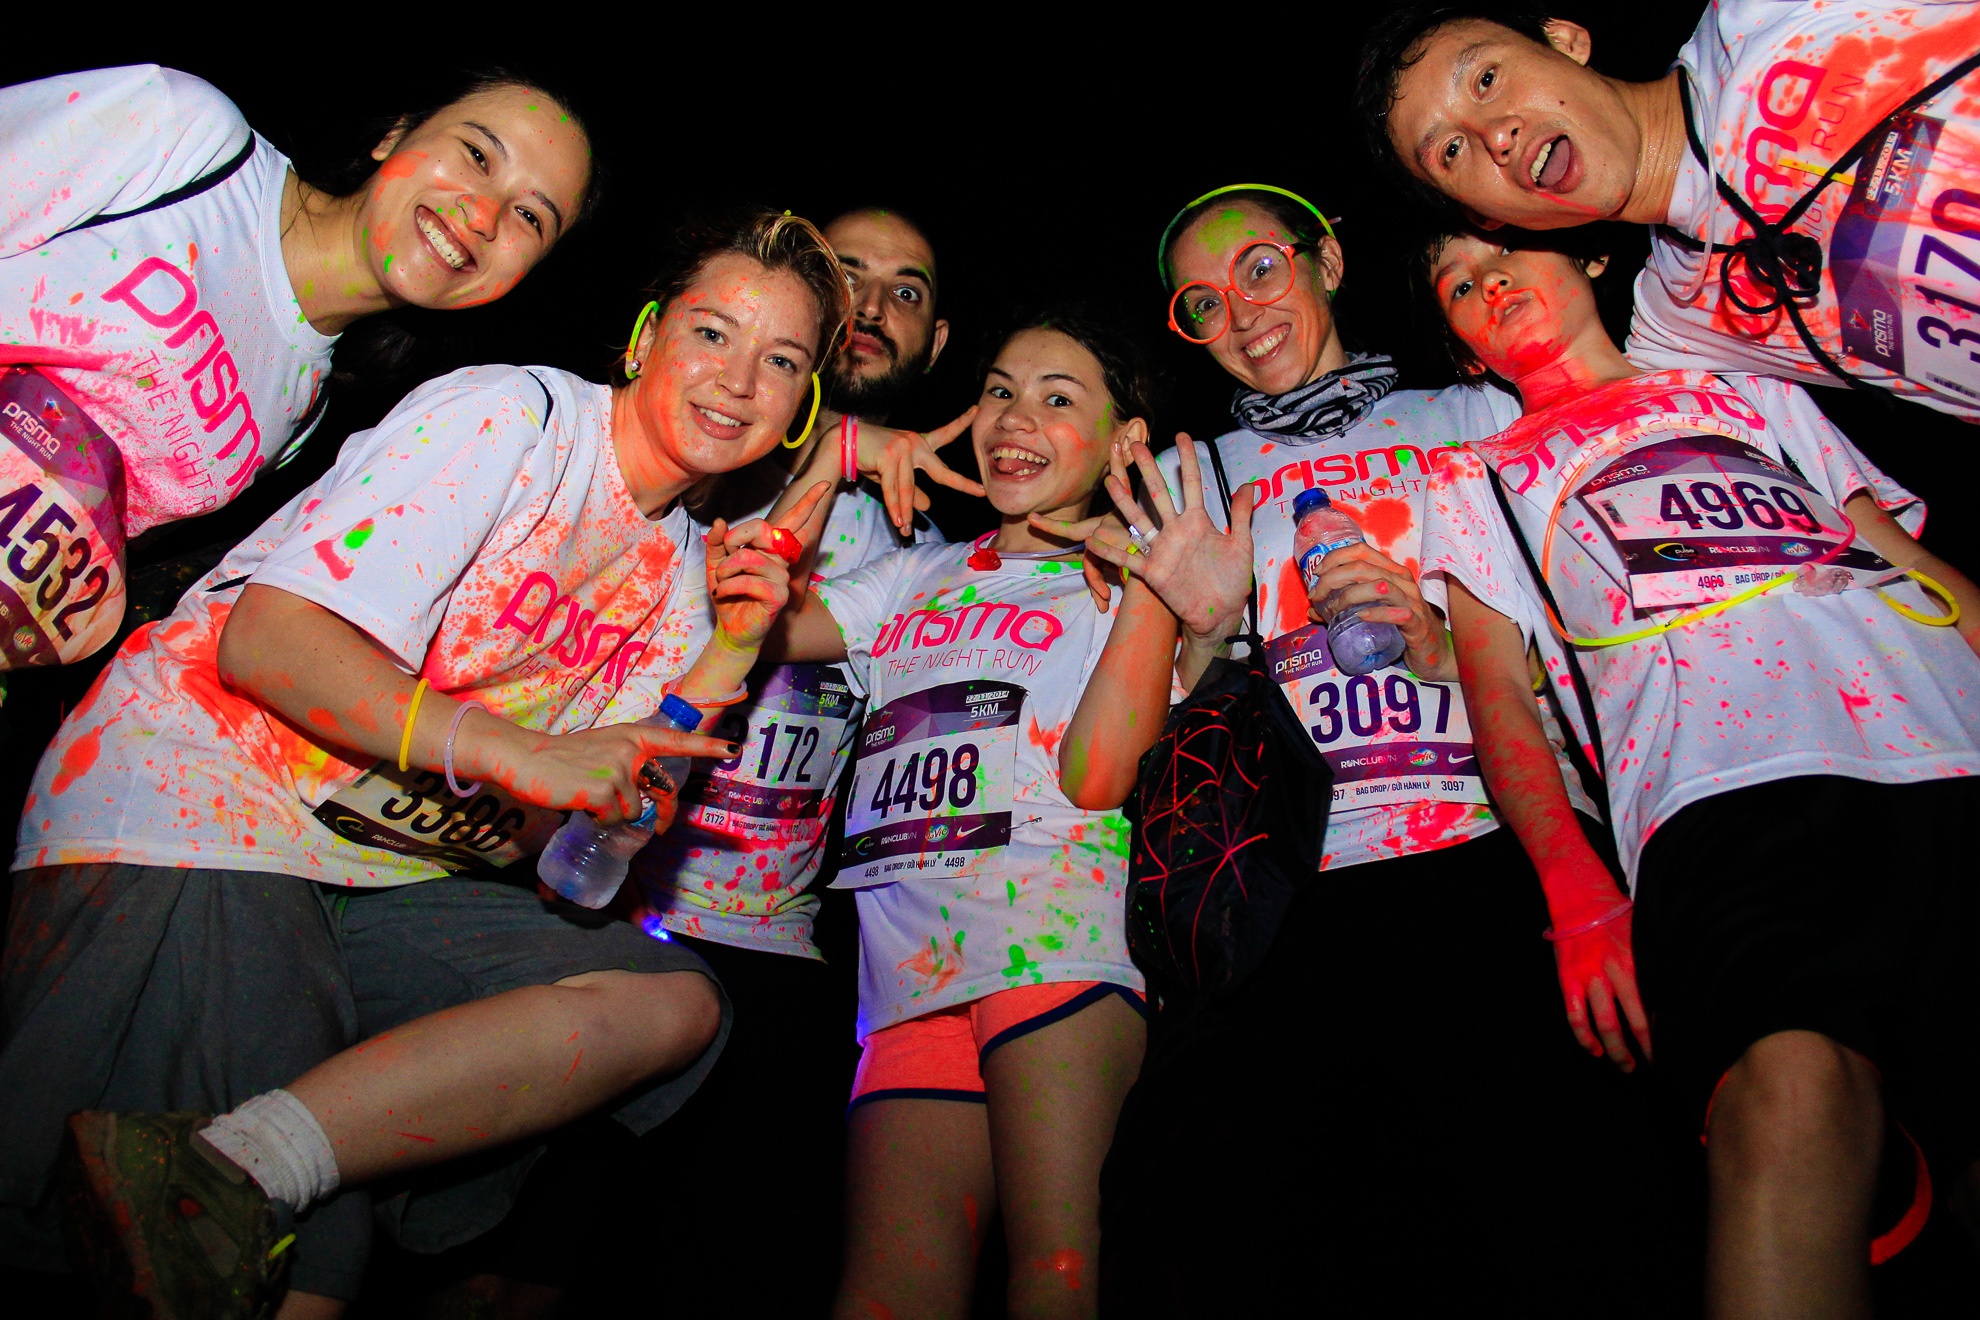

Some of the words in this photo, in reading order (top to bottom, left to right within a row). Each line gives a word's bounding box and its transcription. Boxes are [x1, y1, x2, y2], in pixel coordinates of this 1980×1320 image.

[1810, 73, 1865, 151] RUN
[1884, 148, 1913, 196] 5KM
[1872, 309, 1891, 357] prisma
[101, 256, 266, 502] prism
[2, 401, 61, 455] prisma
[10, 421, 23, 434] THE
[21, 430, 41, 449] NIGHT
[38, 447, 53, 461] RUN
[131, 350, 177, 411] THE
[159, 414, 213, 489] NIGHT
[1339, 479, 1422, 502] NIGHT
[1591, 464, 1648, 486] prisma
[1660, 480, 1823, 535] 4969
[0, 483, 109, 642] 4532
[1735, 573, 1750, 584] BAG
[888, 654, 918, 678] THE
[923, 648, 988, 670] NIGHT
[992, 648, 1042, 677] RUN
[1275, 649, 1322, 675] prisma
[970, 703, 999, 718] 5KM
[1309, 674, 1451, 744] 3097
[866, 725, 895, 746] prisma
[871, 742, 980, 821] 4498
[1356, 786, 1369, 795] BAG
[1441, 780, 1464, 792] 3097
[381, 770, 527, 853] 3386
[704, 812, 725, 826] 3172
[864, 866, 879, 878] 4498
[944, 856, 966, 868] 4498
